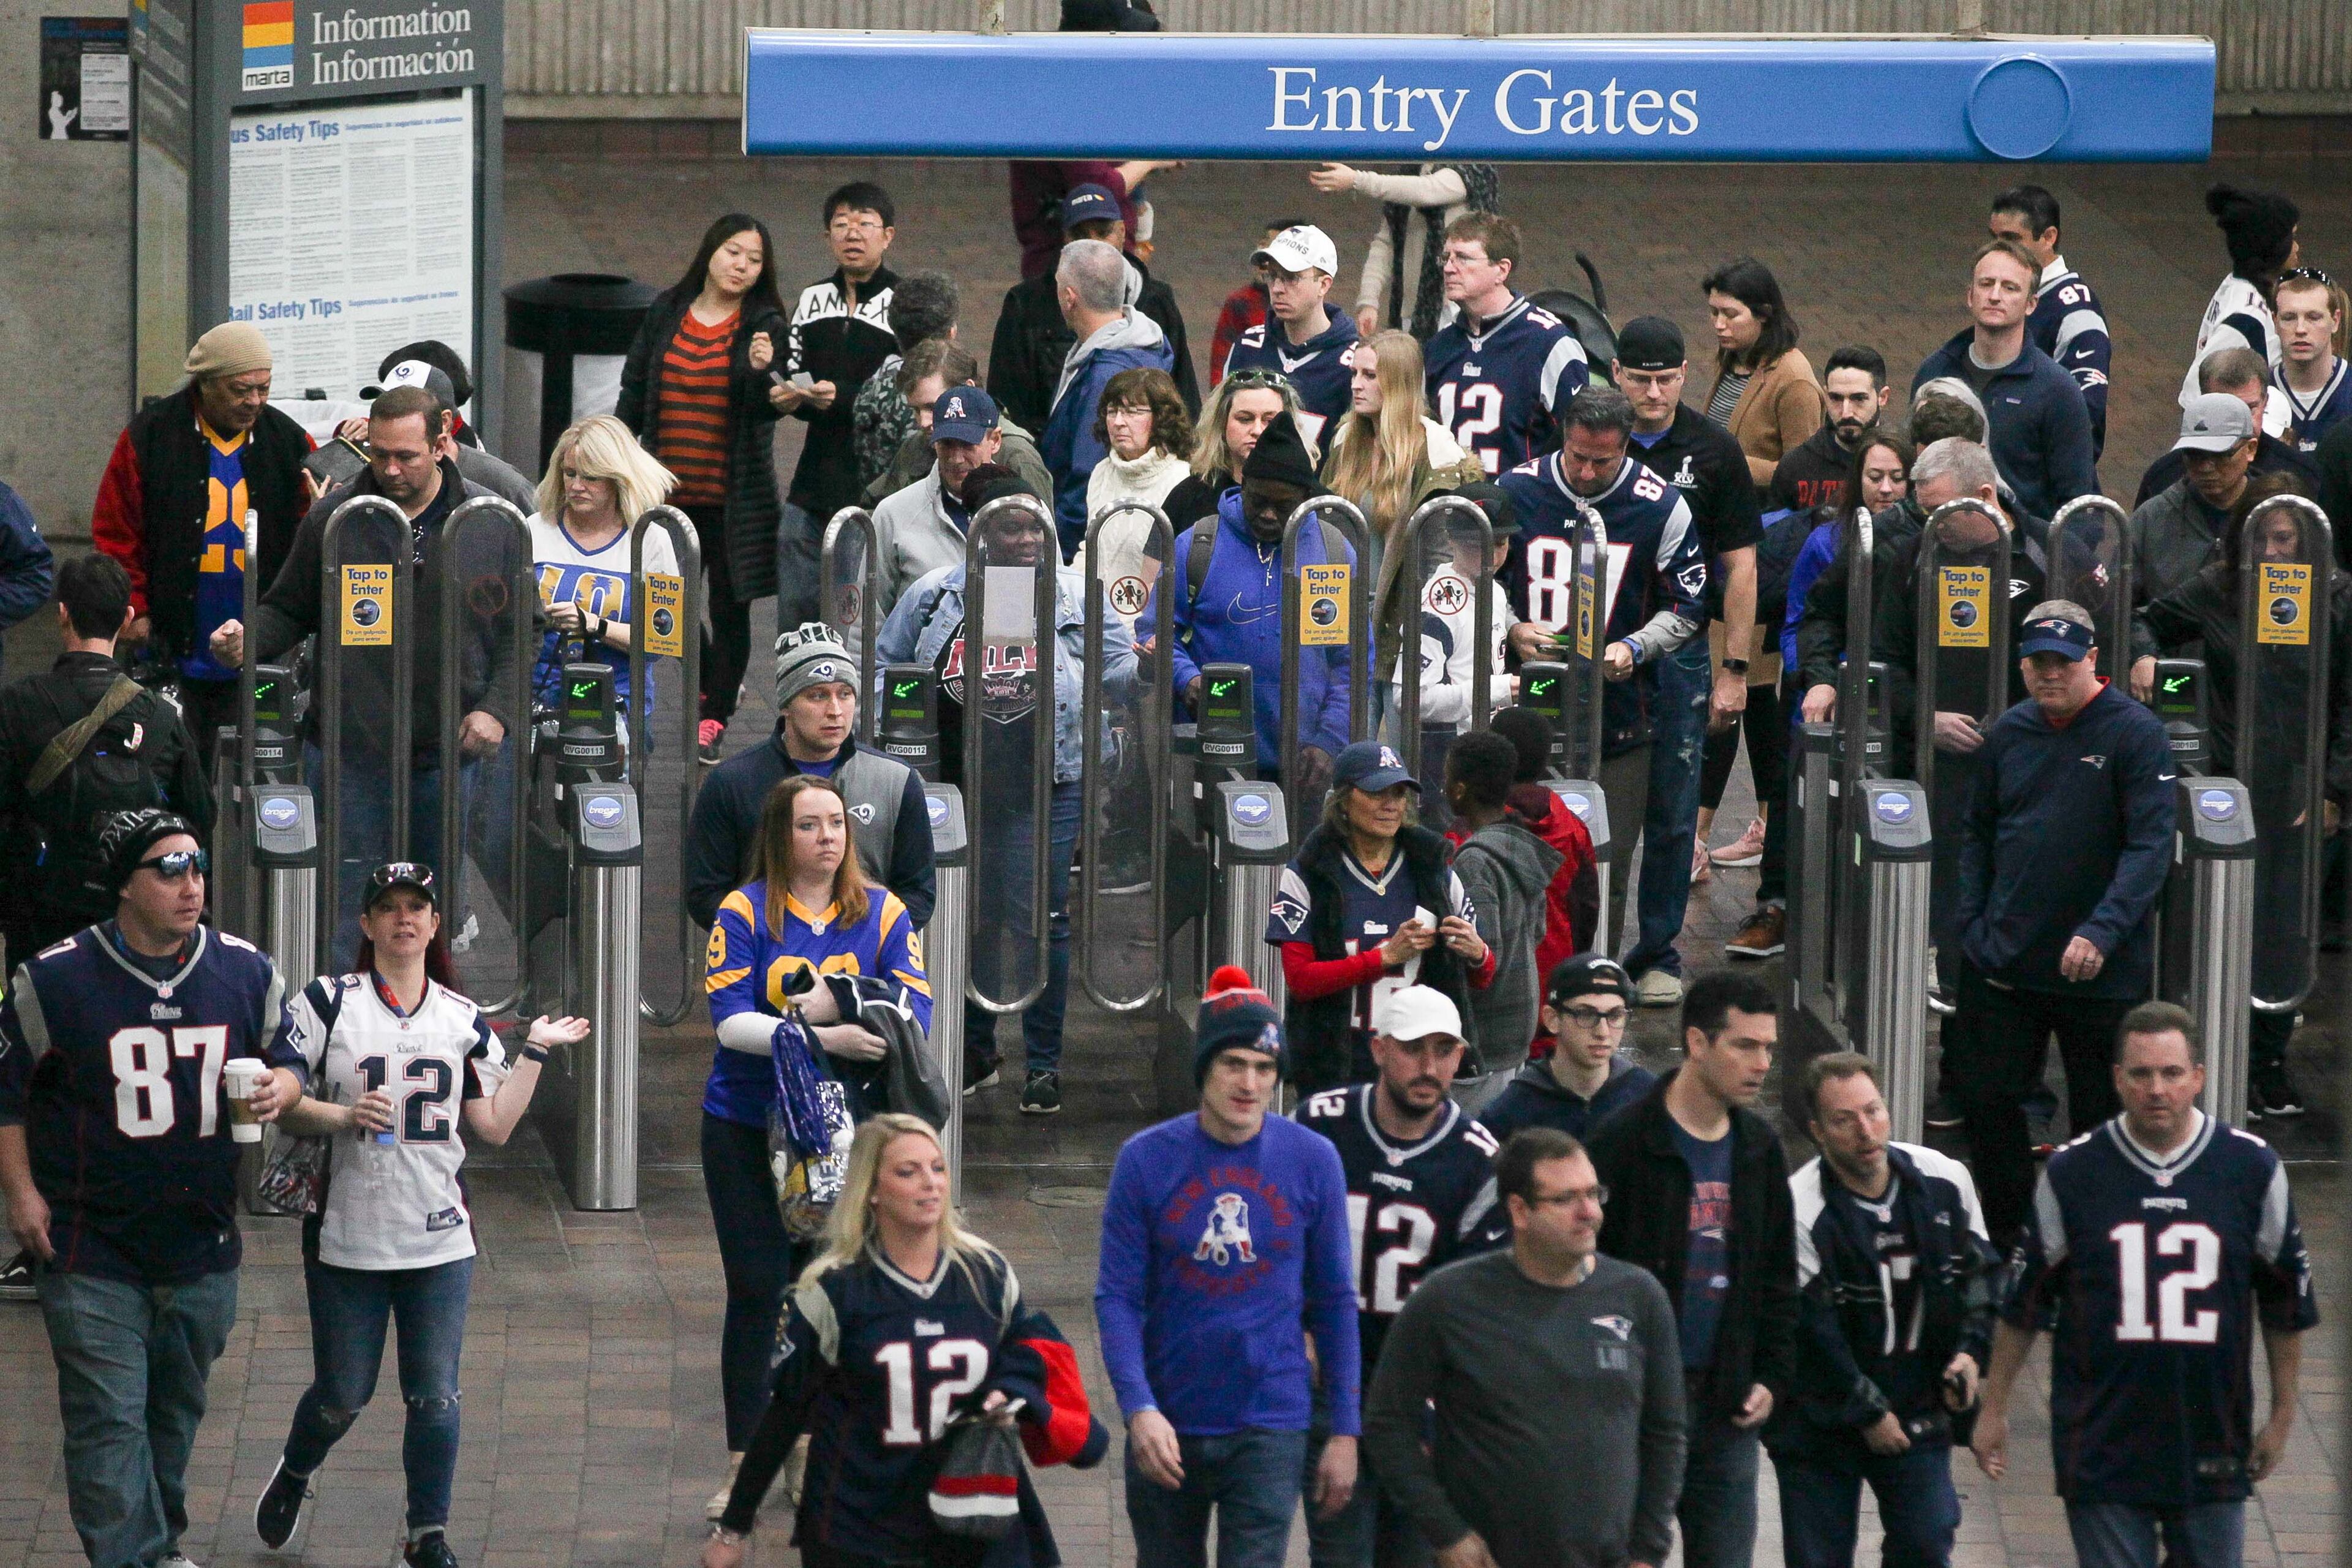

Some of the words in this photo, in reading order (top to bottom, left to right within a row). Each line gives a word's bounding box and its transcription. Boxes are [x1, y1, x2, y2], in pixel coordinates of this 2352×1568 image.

[312, 2, 471, 45] Information
[312, 39, 475, 85] Información
[244, 69, 290, 86] marta
[1266, 67, 1470, 151] Entry
[1495, 69, 1699, 136] Gates
[229, 129, 250, 143] us
[255, 123, 304, 142] Safety
[308, 120, 340, 140] Tips
[1277, 239, 1309, 255] PIONS
[2058, 283, 2092, 305] 87
[258, 301, 305, 320] Safety
[310, 298, 342, 318] Tips
[1437, 382, 1504, 475] 12
[1633, 464, 1667, 502] 87
[347, 568, 371, 582] Tap
[374, 570, 387, 579] to
[1306, 568, 1329, 582] Tap
[1333, 569, 1345, 579] to
[1943, 570, 1967, 584] Tap
[1972, 571, 1985, 582] to
[2266, 567, 2290, 581] Tap
[2293, 569, 2307, 579] to
[351, 584, 384, 595] Enter
[649, 576, 666, 592] Tap
[669, 581, 679, 592] to
[1310, 584, 1341, 595] Enter
[1525, 535, 1634, 634] 87
[1948, 585, 1980, 597] Enter
[2269, 582, 2302, 594] Enter
[652, 592, 676, 606] Enter
[254, 748, 282, 756] G00114
[564, 746, 604, 755] RVG00113
[887, 745, 925, 754] RVG00112
[1204, 744, 1243, 753] RVG00111
[108, 1025, 230, 1139] 87
[355, 1054, 454, 1145] 12
[1347, 1193, 1437, 1314] 12
[2109, 1221, 2221, 1344] 12
[875, 1338, 990, 1446] 12
